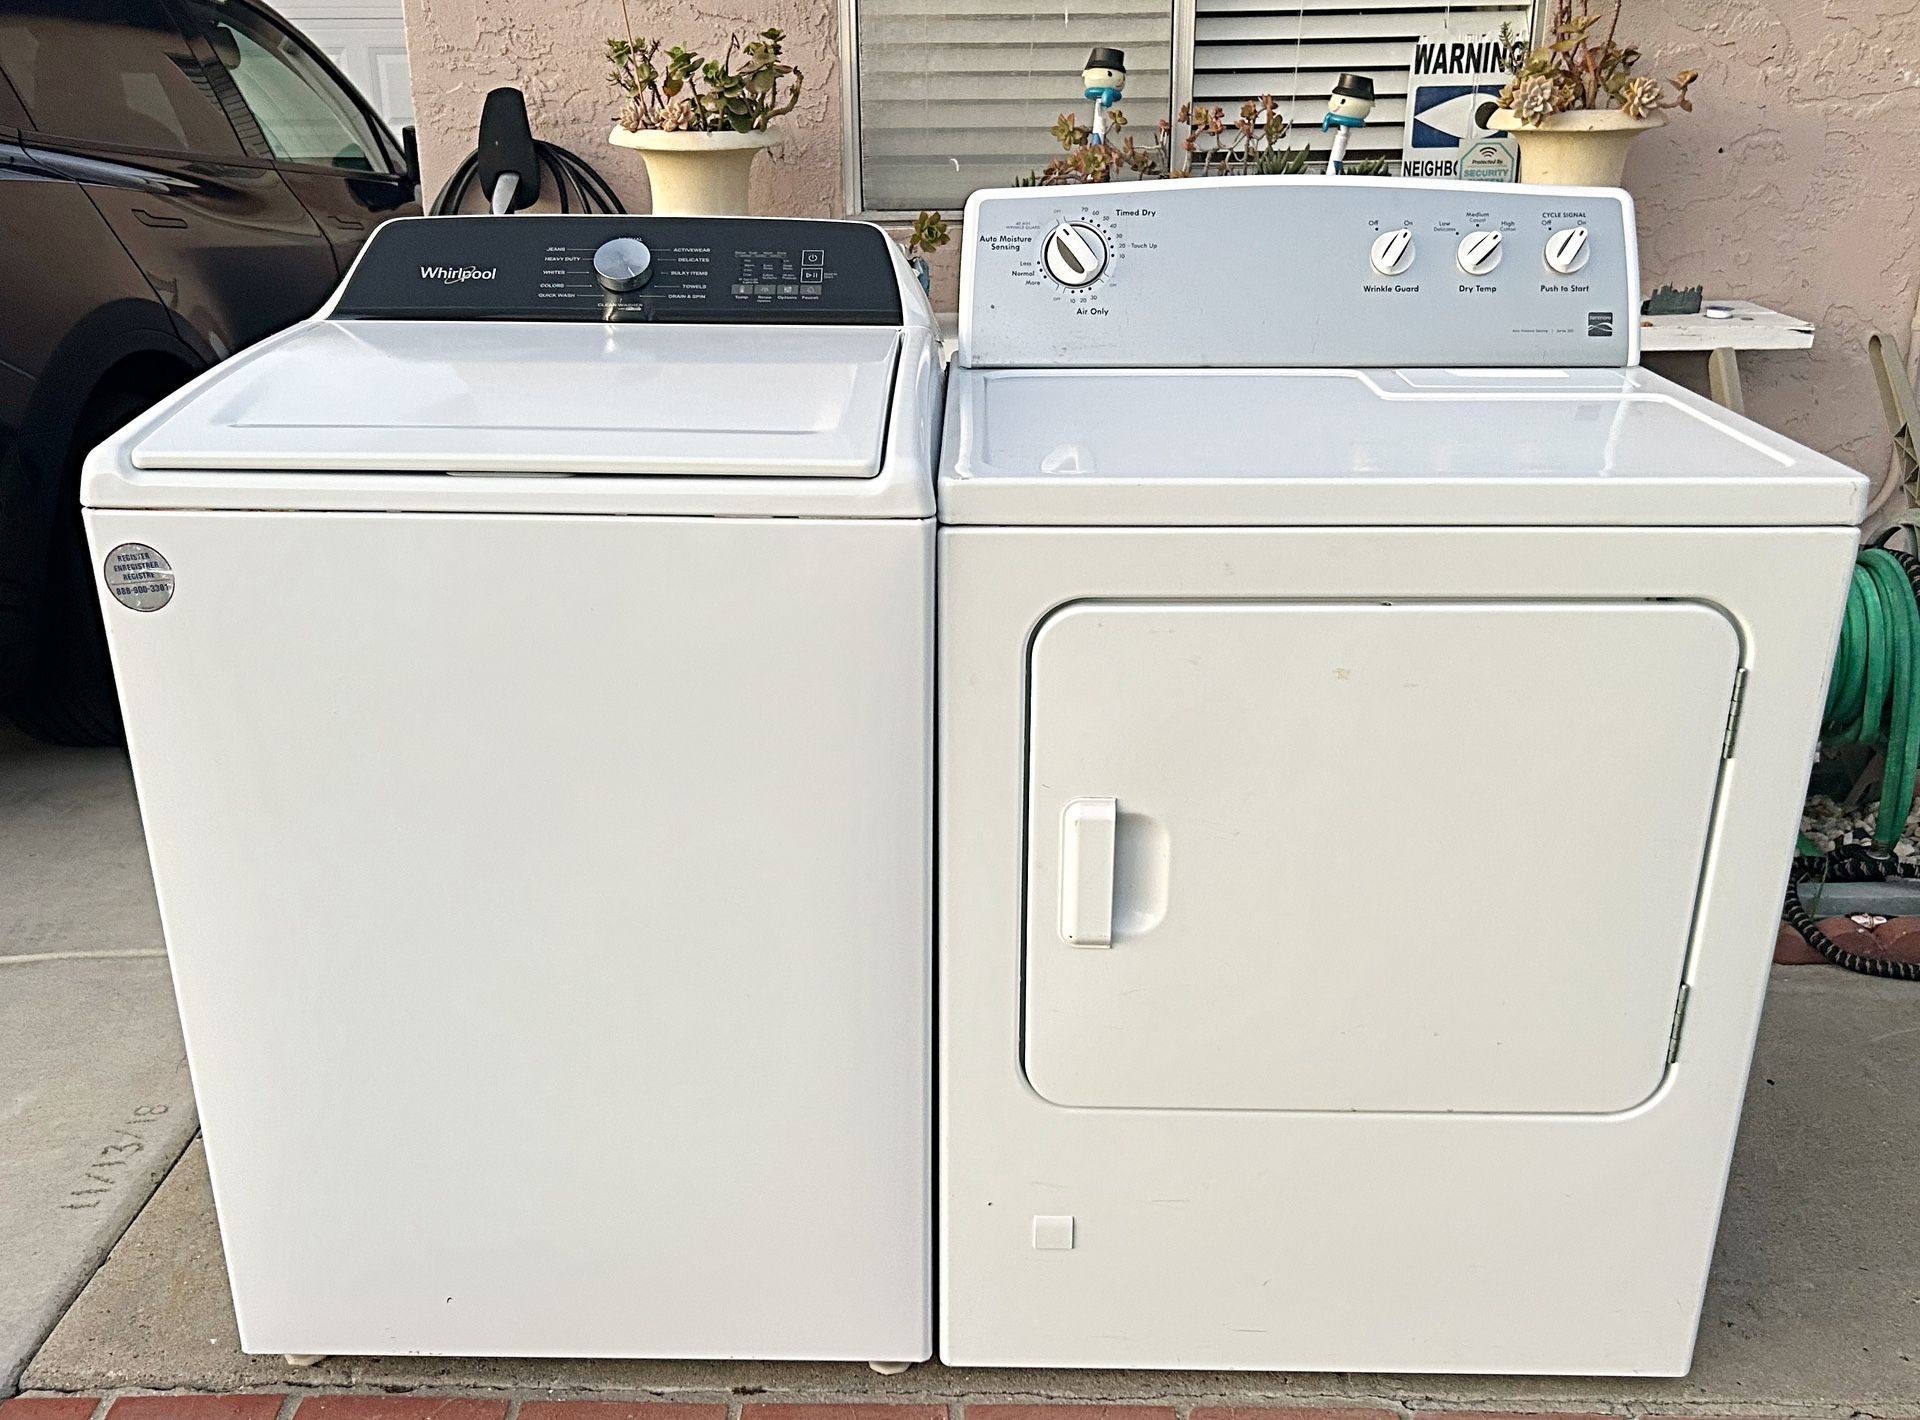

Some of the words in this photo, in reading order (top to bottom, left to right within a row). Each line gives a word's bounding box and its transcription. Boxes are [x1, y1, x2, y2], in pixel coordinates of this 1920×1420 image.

[1414, 41, 1525, 75] WARNING
[1464, 168, 1509, 177] SECURITY
[1142, 209, 1156, 217] Dry
[991, 243, 1020, 252] Sensing
[420, 265, 497, 284] Whirlpool
[1459, 285, 1473, 293] Dry
[1475, 285, 1497, 293] Temp
[1090, 307, 1109, 316] Only
[117, 552, 150, 562] REGISTER
[113, 561, 160, 572] ENREGISTRER
[58, 1104, 169, 1209] 11/13/18
